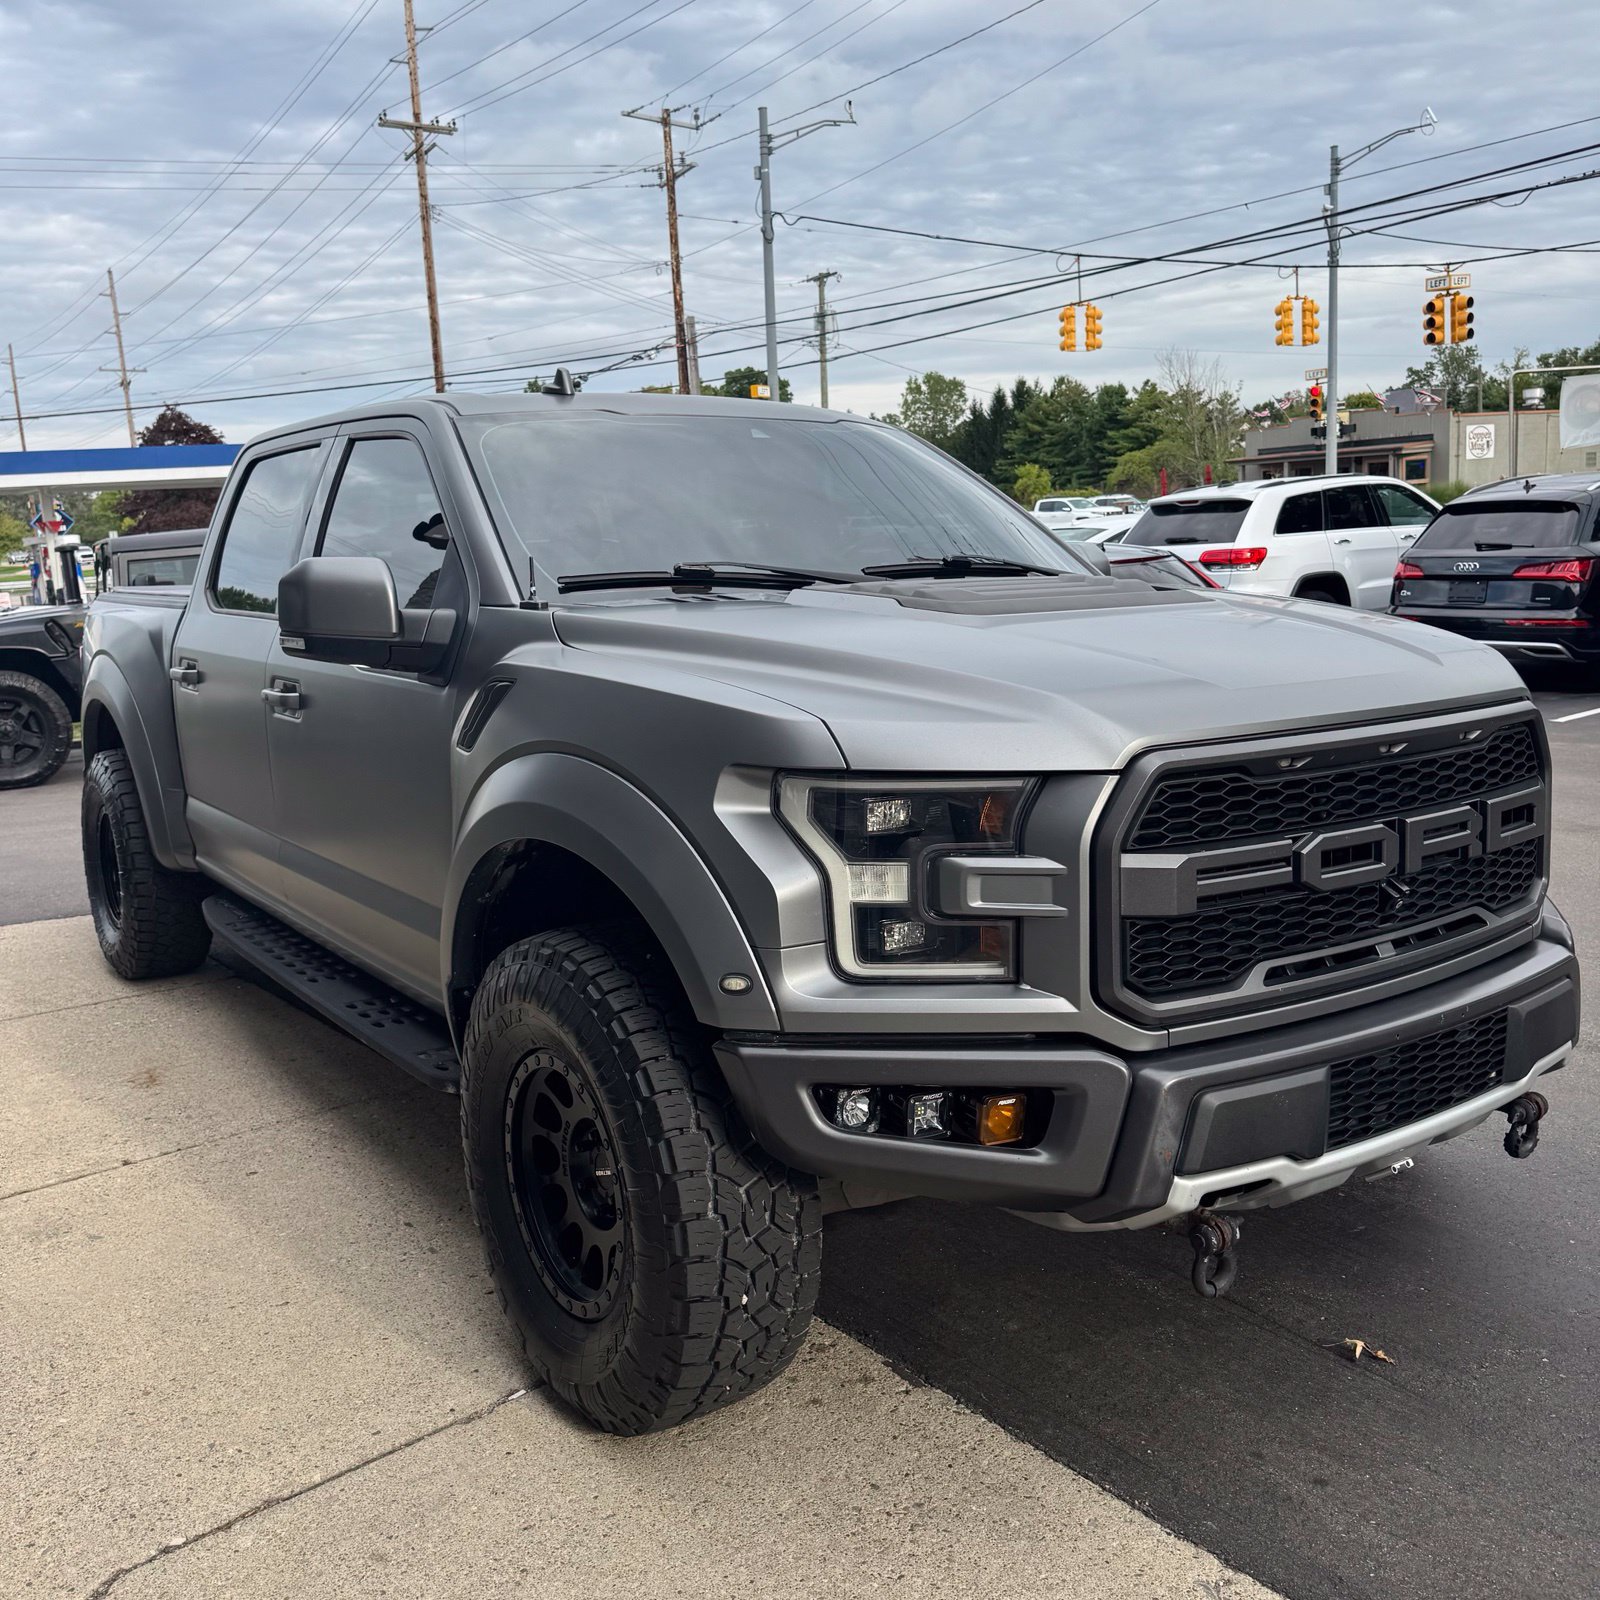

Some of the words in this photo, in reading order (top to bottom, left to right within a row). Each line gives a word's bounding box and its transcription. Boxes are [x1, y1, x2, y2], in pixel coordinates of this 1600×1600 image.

[1430, 278, 1447, 289] LEFT
[1453, 276, 1468, 286] LEFT
[1308, 370, 1323, 378] LEFT
[1121, 782, 1545, 918] FORD
[850, 1087, 872, 1096] RIGID
[921, 1092, 943, 1101] RIGID
[997, 1098, 1017, 1106] RIGID
[562, 1120, 571, 1177] METHOD
